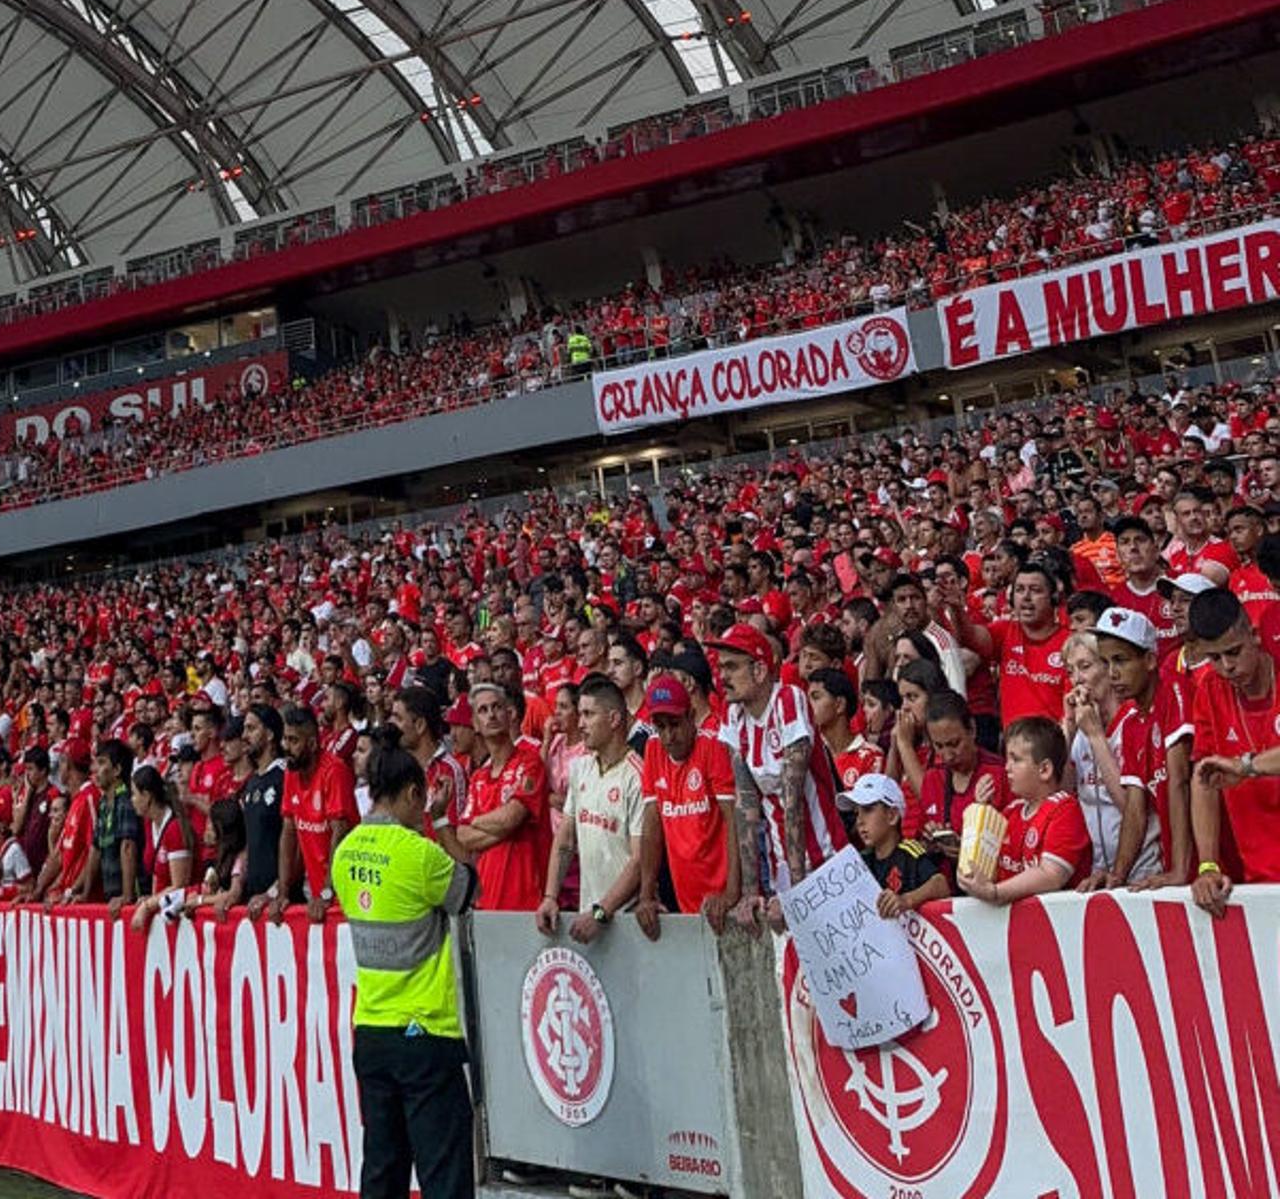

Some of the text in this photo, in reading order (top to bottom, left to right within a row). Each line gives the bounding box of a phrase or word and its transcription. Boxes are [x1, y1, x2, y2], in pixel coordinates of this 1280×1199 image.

[945, 294, 980, 367] É
[995, 290, 1032, 356] A
[1043, 230, 1280, 346] MULHER
[15, 407, 91, 445] DO
[109, 377, 217, 424] SUL
[600, 367, 708, 422] CRIANÇA
[712, 339, 849, 402] COLORADA
[349, 864, 382, 887] 1615
[559, 1104, 588, 1120] 1905
